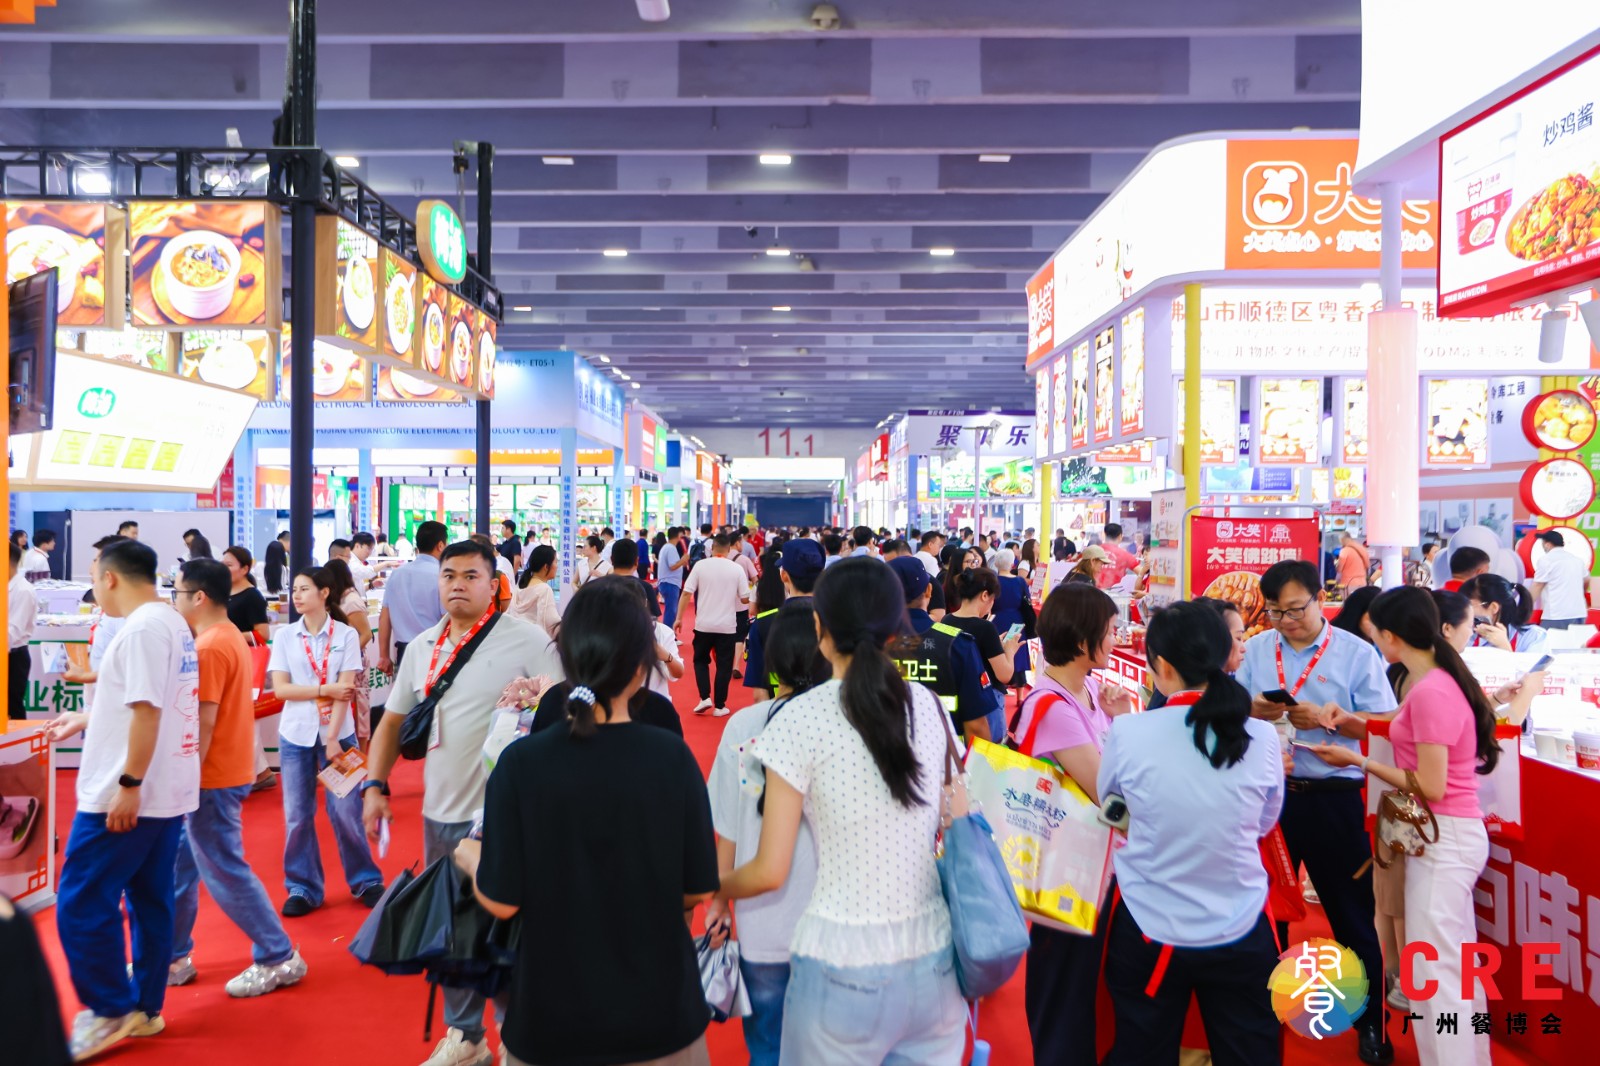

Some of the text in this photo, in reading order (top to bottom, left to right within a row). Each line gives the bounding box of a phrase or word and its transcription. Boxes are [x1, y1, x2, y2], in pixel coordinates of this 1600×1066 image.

[1543, 101, 1594, 148] 炒鸡酱
[529, 359, 555, 367] ET05-1
[758, 426, 813, 457] 11.1
[935, 424, 1032, 446] 聚乐
[1234, 523, 1261, 537] 大笑
[1206, 546, 1297, 565] 大笑佛跳墙
[891, 658, 938, 681] 卫士
[1474, 842, 1600, 1006] 百味
